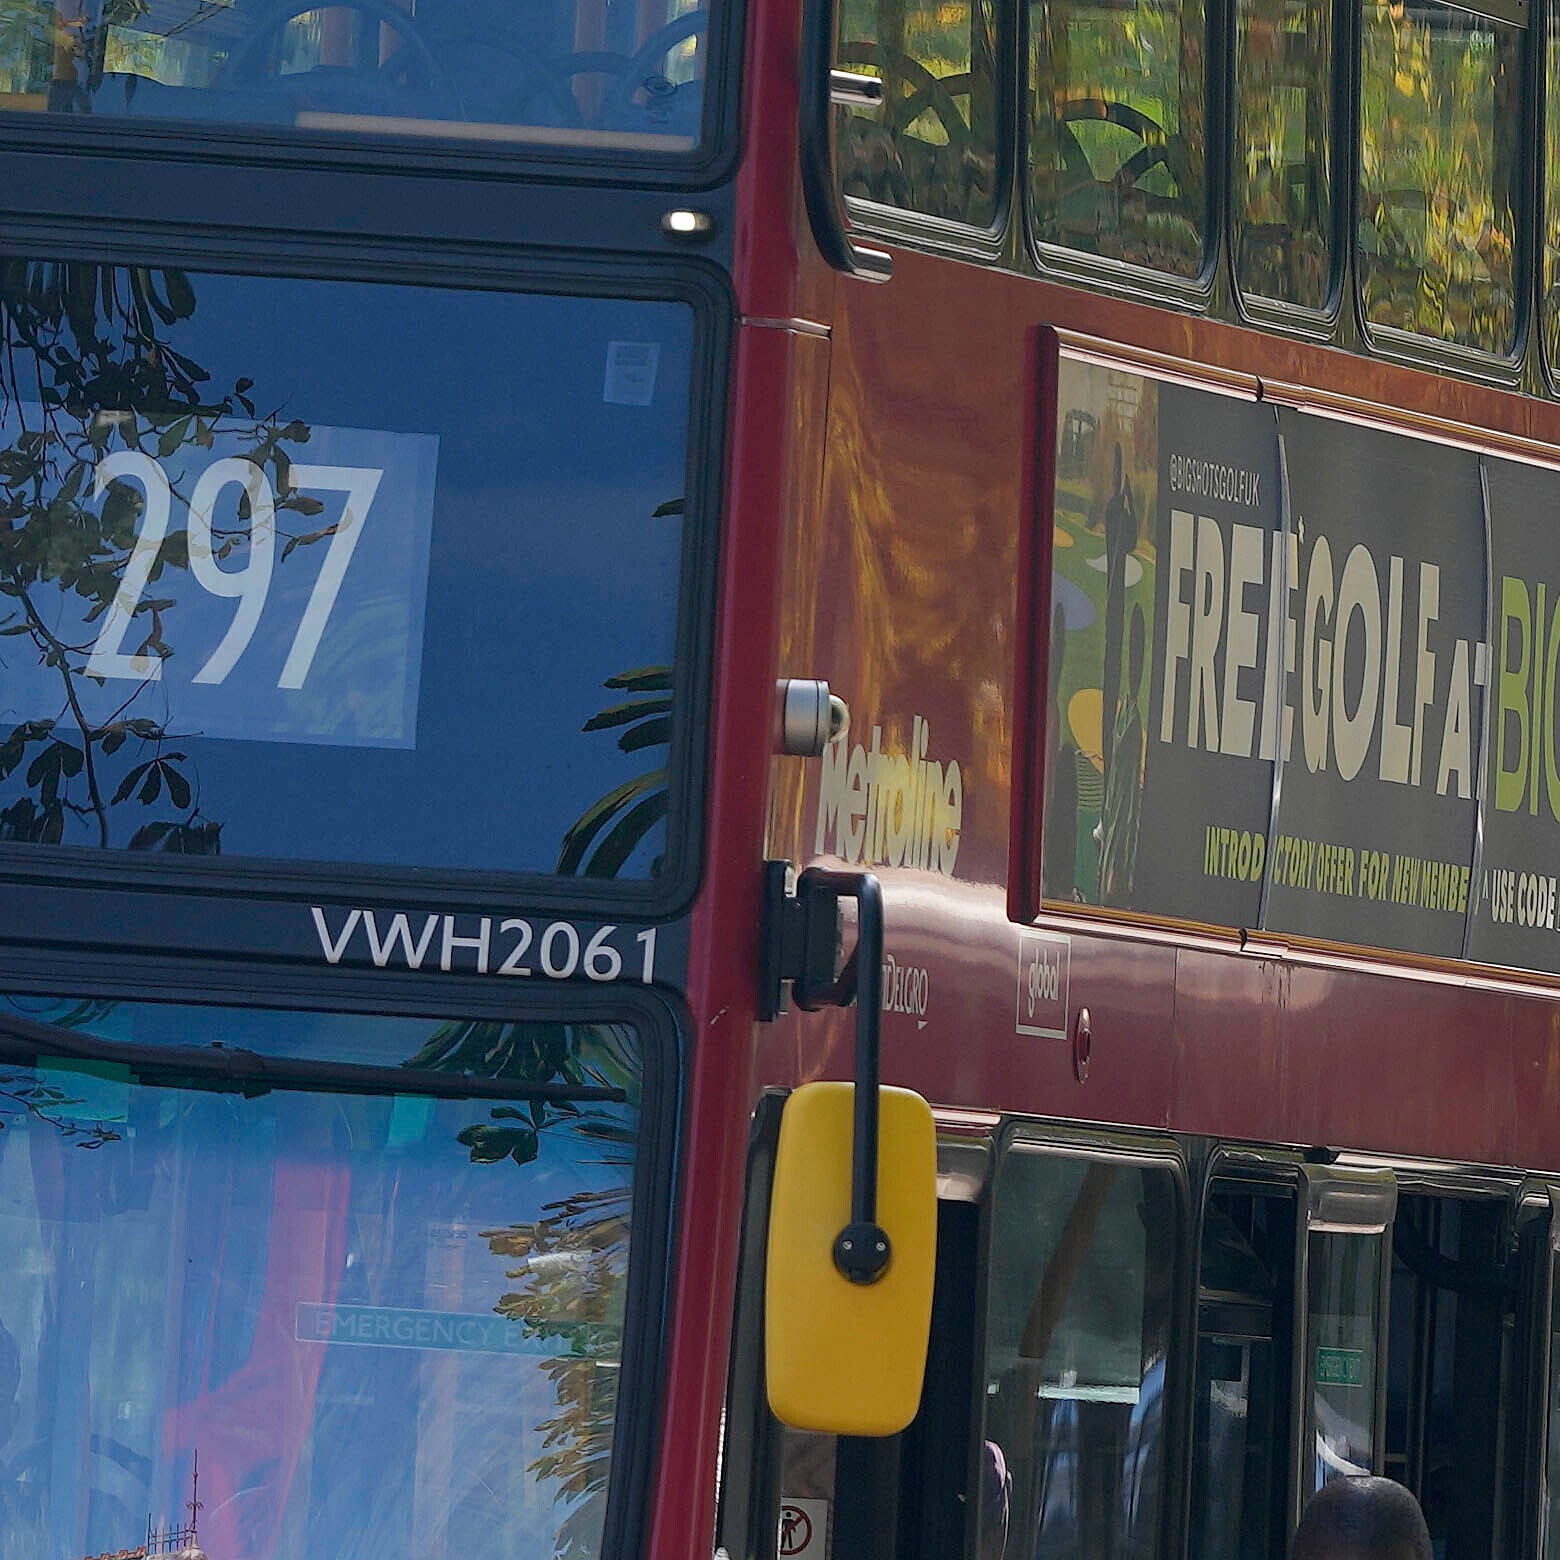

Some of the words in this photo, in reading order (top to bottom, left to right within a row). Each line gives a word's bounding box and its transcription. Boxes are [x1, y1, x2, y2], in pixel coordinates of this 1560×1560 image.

[1169, 453, 1261, 507] @BIGSHOTSGOLFUK
[84, 450, 385, 691] 297
[1301, 534, 1441, 787] GOLF
[814, 713, 964, 875] Metroline
[1204, 825, 1316, 890] INTRODCTORY
[1316, 843, 1354, 897] OFFER
[1358, 849, 1390, 901] FOR
[1390, 855, 1420, 905] NEW
[1491, 868, 1516, 924] USE
[1516, 870, 1558, 929] CODE
[311, 906, 659, 985] VWH2061
[1027, 947, 1060, 1018] global
[314, 1310, 491, 1346] EMERGENCY
